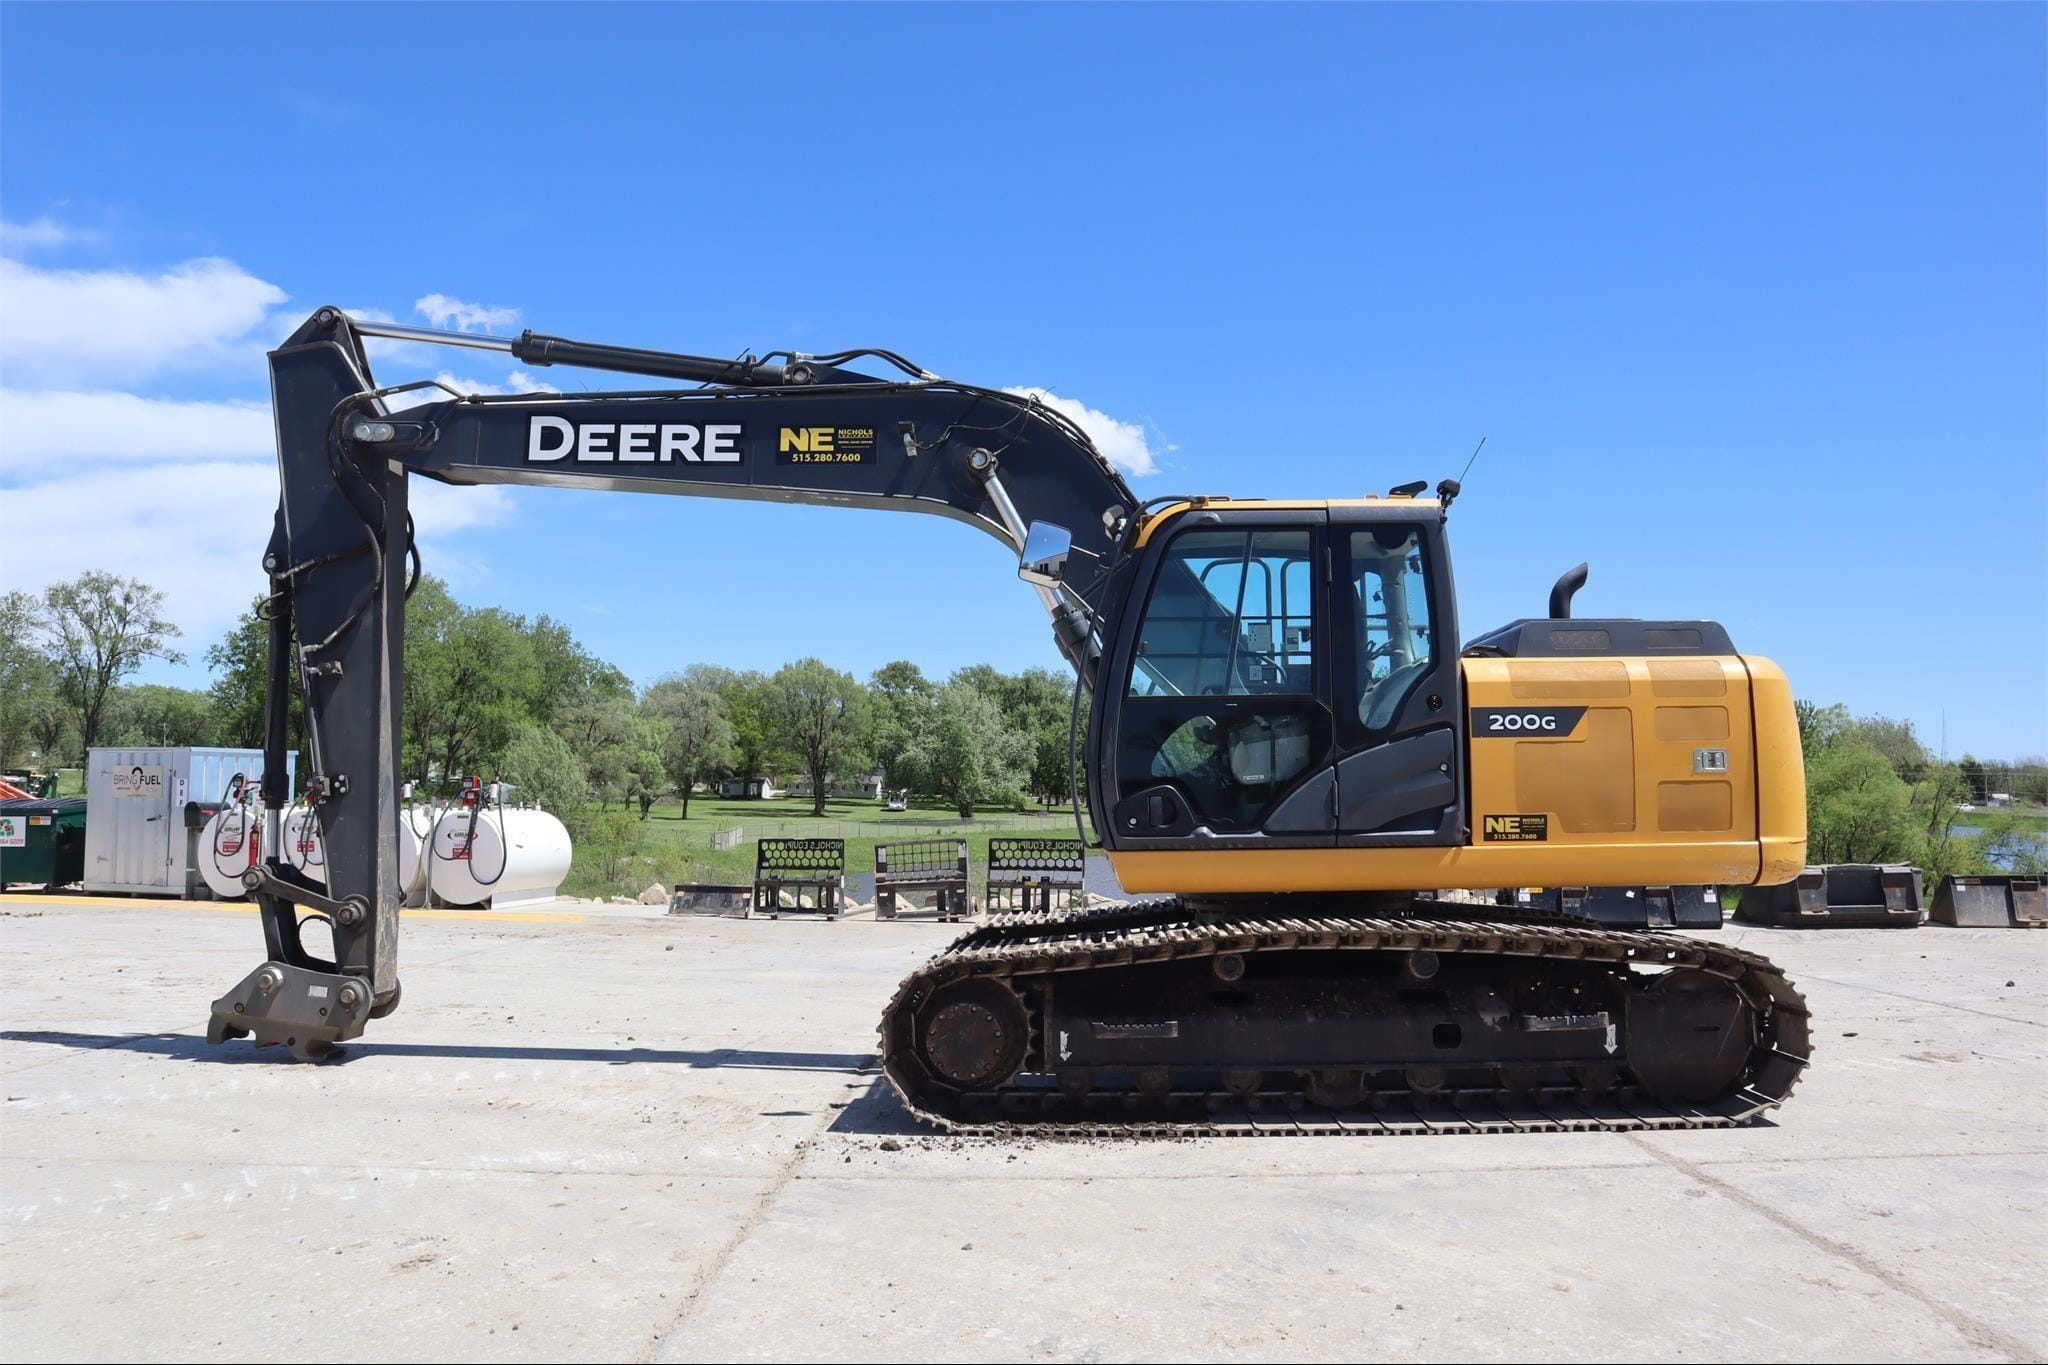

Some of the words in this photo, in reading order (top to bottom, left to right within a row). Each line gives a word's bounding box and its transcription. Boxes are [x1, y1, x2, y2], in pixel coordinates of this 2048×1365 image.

[528, 415, 742, 462] DEERE
[780, 427, 835, 452] NE
[792, 453, 861, 462] 515.280.7600
[1489, 714, 1556, 730] 200G
[113, 774, 138, 785] BRING
[139, 775, 161, 785] FUEL
[1486, 817, 1520, 833] NE
